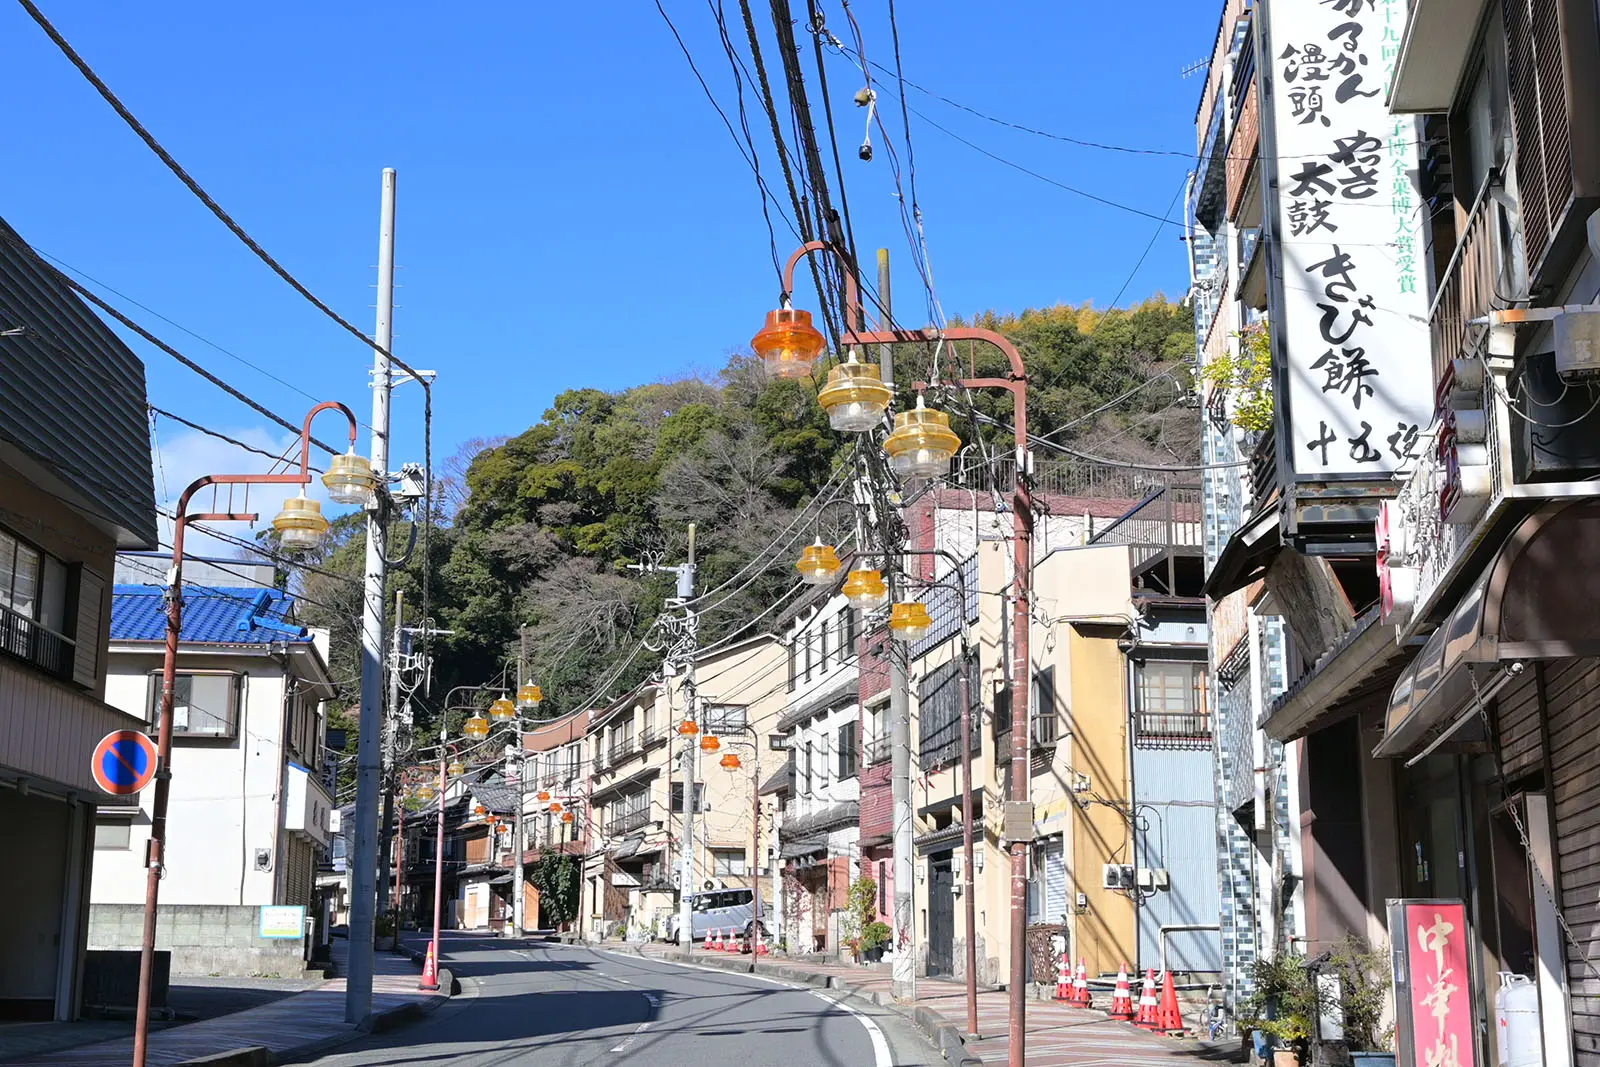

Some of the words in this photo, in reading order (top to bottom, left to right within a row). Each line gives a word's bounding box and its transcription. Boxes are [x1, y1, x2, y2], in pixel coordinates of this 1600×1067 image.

[1287, 161, 1338, 237] 太鼓
[1306, 243, 1380, 410] きび餅
